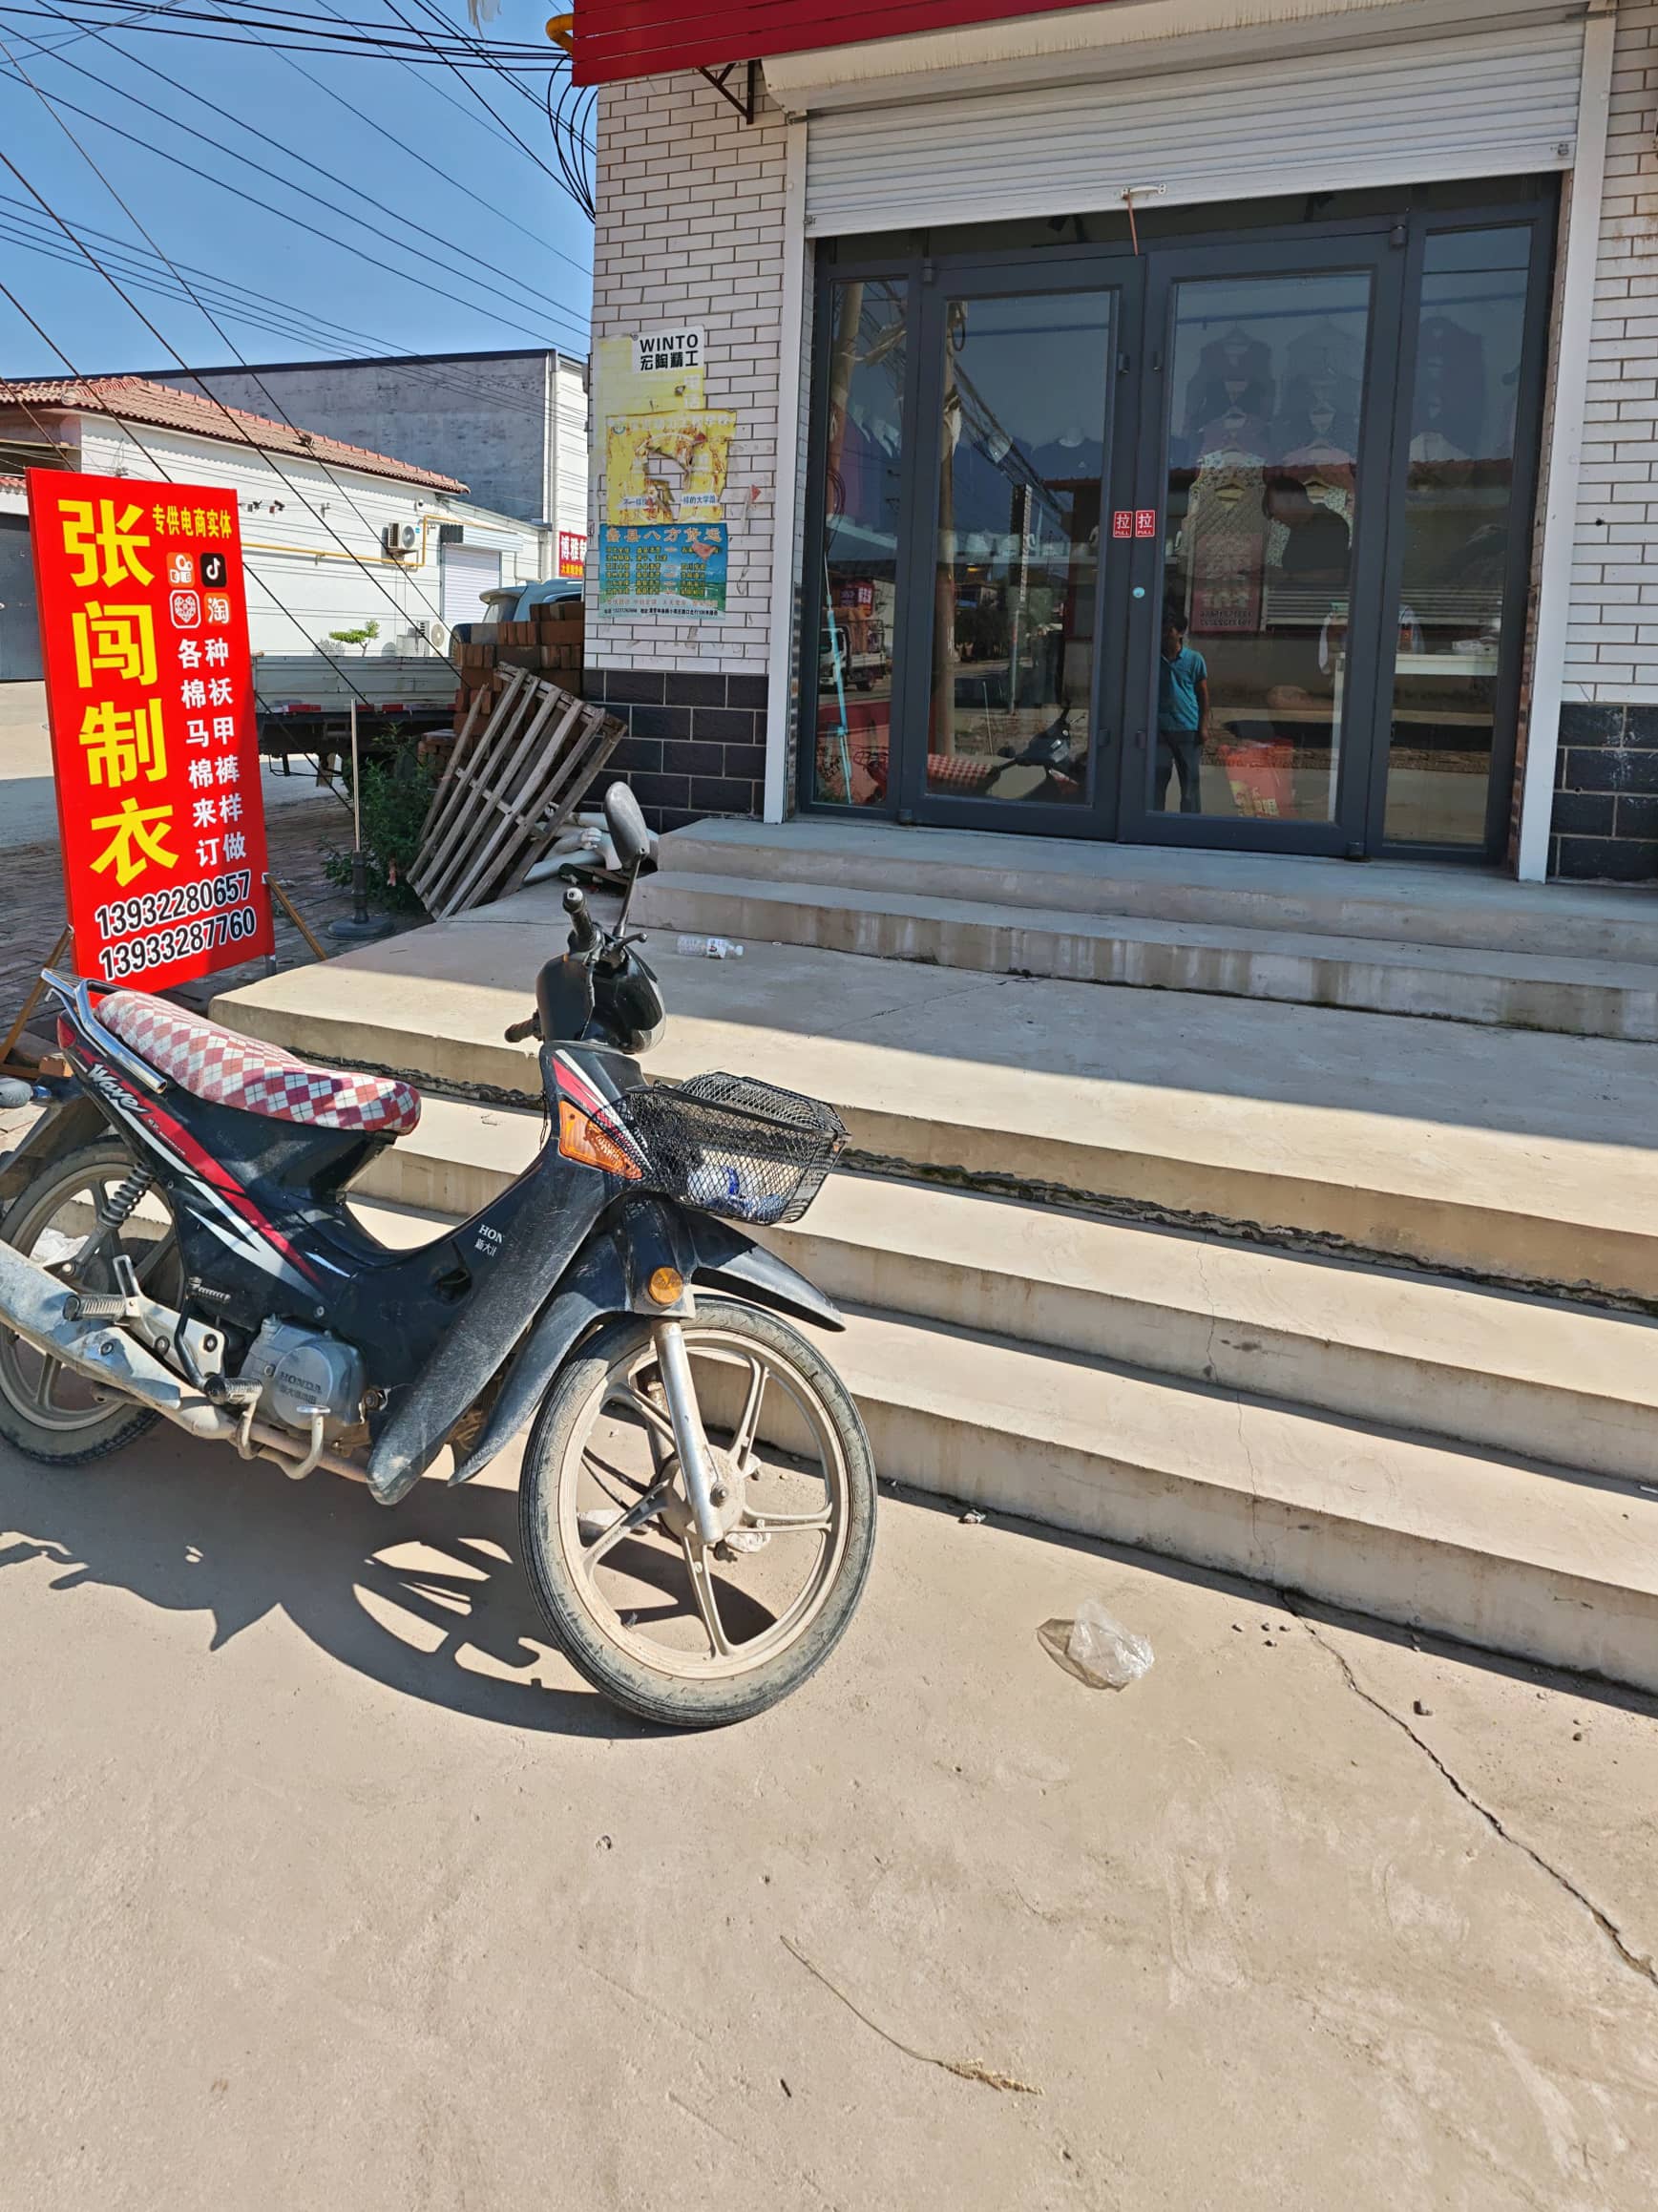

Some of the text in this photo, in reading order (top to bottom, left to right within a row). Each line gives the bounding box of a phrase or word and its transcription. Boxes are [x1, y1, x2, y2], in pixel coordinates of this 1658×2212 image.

[640, 334, 699, 352] WINTO
[640, 350, 699, 370] 宏陶精工
[153, 504, 232, 538] 专供电商实体
[1117, 514, 1130, 529] 拉
[1138, 513, 1152, 529] 拉
[208, 598, 229, 624] 淘
[178, 638, 229, 669] 各种
[58, 499, 179, 887] 张闯制衣
[180, 678, 234, 709] 棉袄
[186, 717, 235, 748] 马甲
[188, 755, 241, 790] 棉裤
[193, 793, 243, 828] 来样
[196, 832, 247, 869] 订做
[95, 870, 251, 939] 13932280657
[99, 906, 256, 980] 13933287760
[88, 1064, 150, 1113] Wave
[281, 1372, 323, 1394] HONDA
